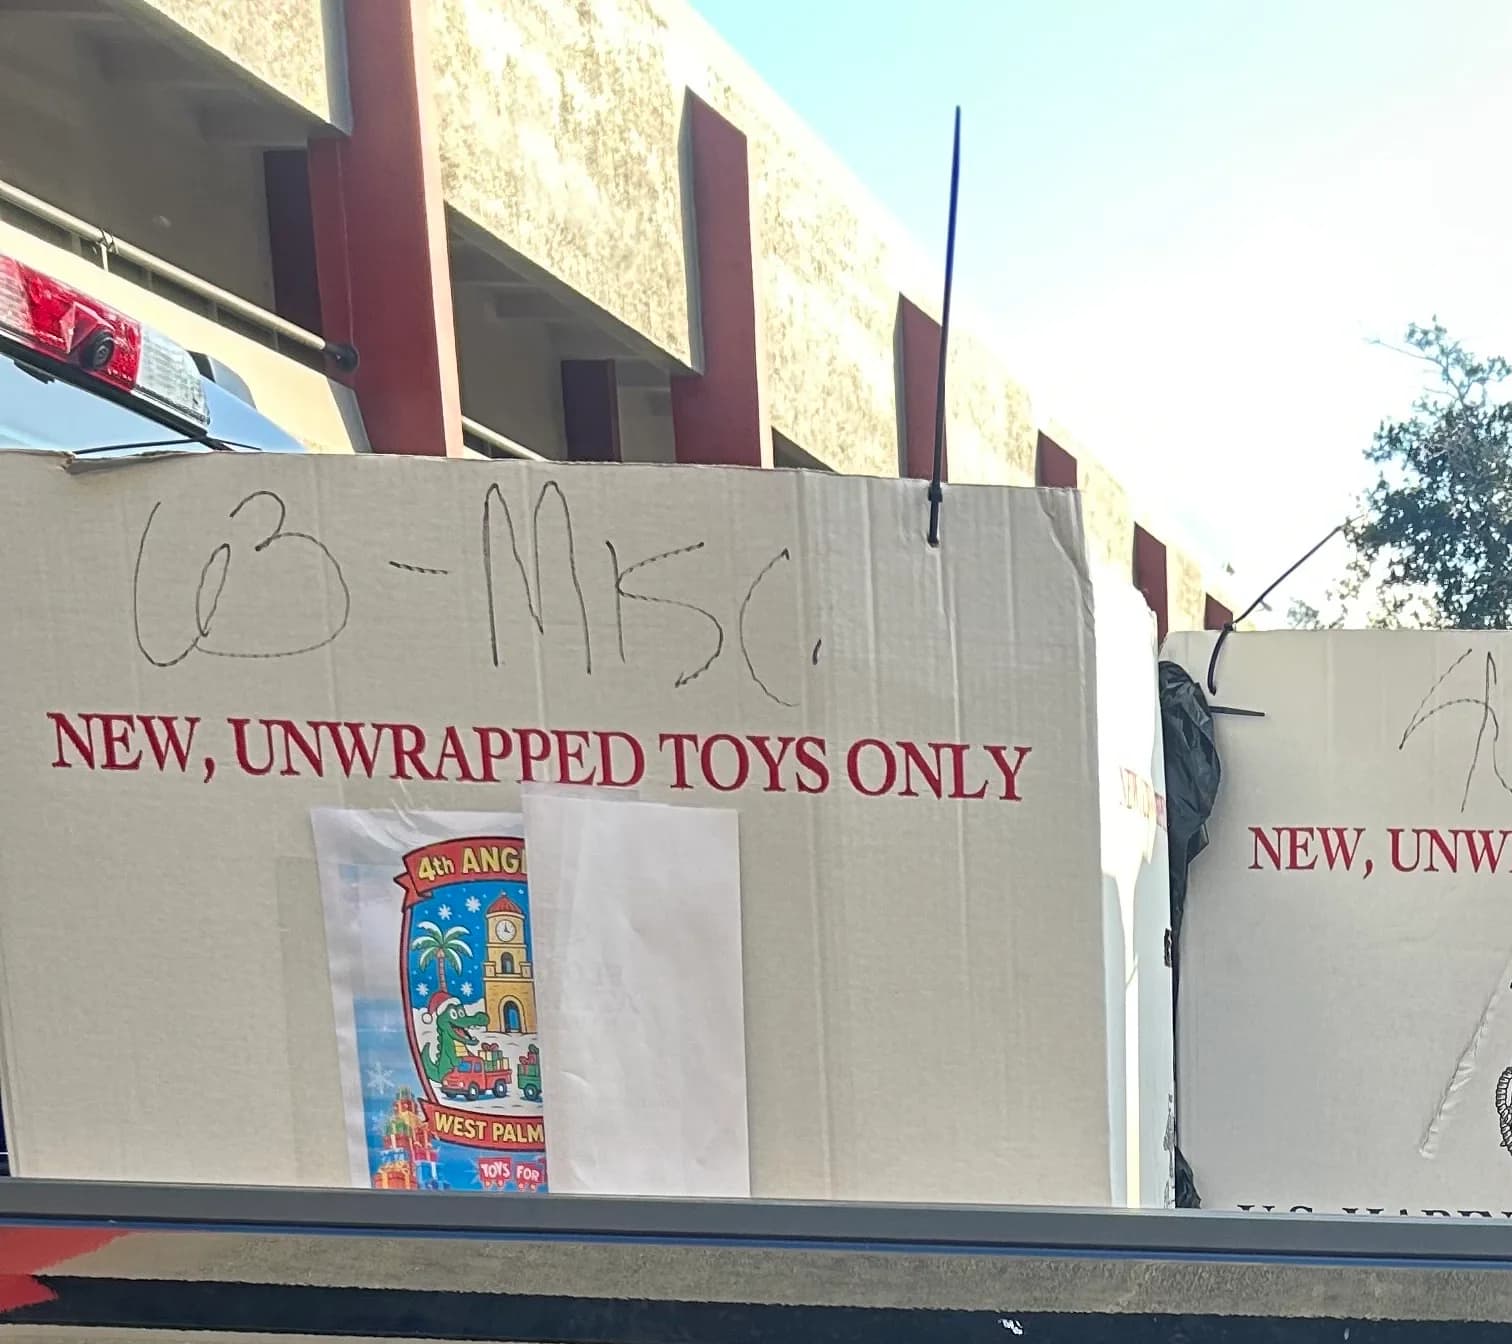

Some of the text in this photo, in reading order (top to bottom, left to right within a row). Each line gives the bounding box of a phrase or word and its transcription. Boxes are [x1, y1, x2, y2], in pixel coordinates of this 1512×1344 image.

[47, 711, 1032, 802] NEW, UNWRAPPED TOYS ONLY
[418, 856, 455, 881] 4th
[1248, 826, 1376, 881] NEW,
[434, 1111, 545, 1143] WEST PALM
[480, 1160, 541, 1181] TOYS FOR
